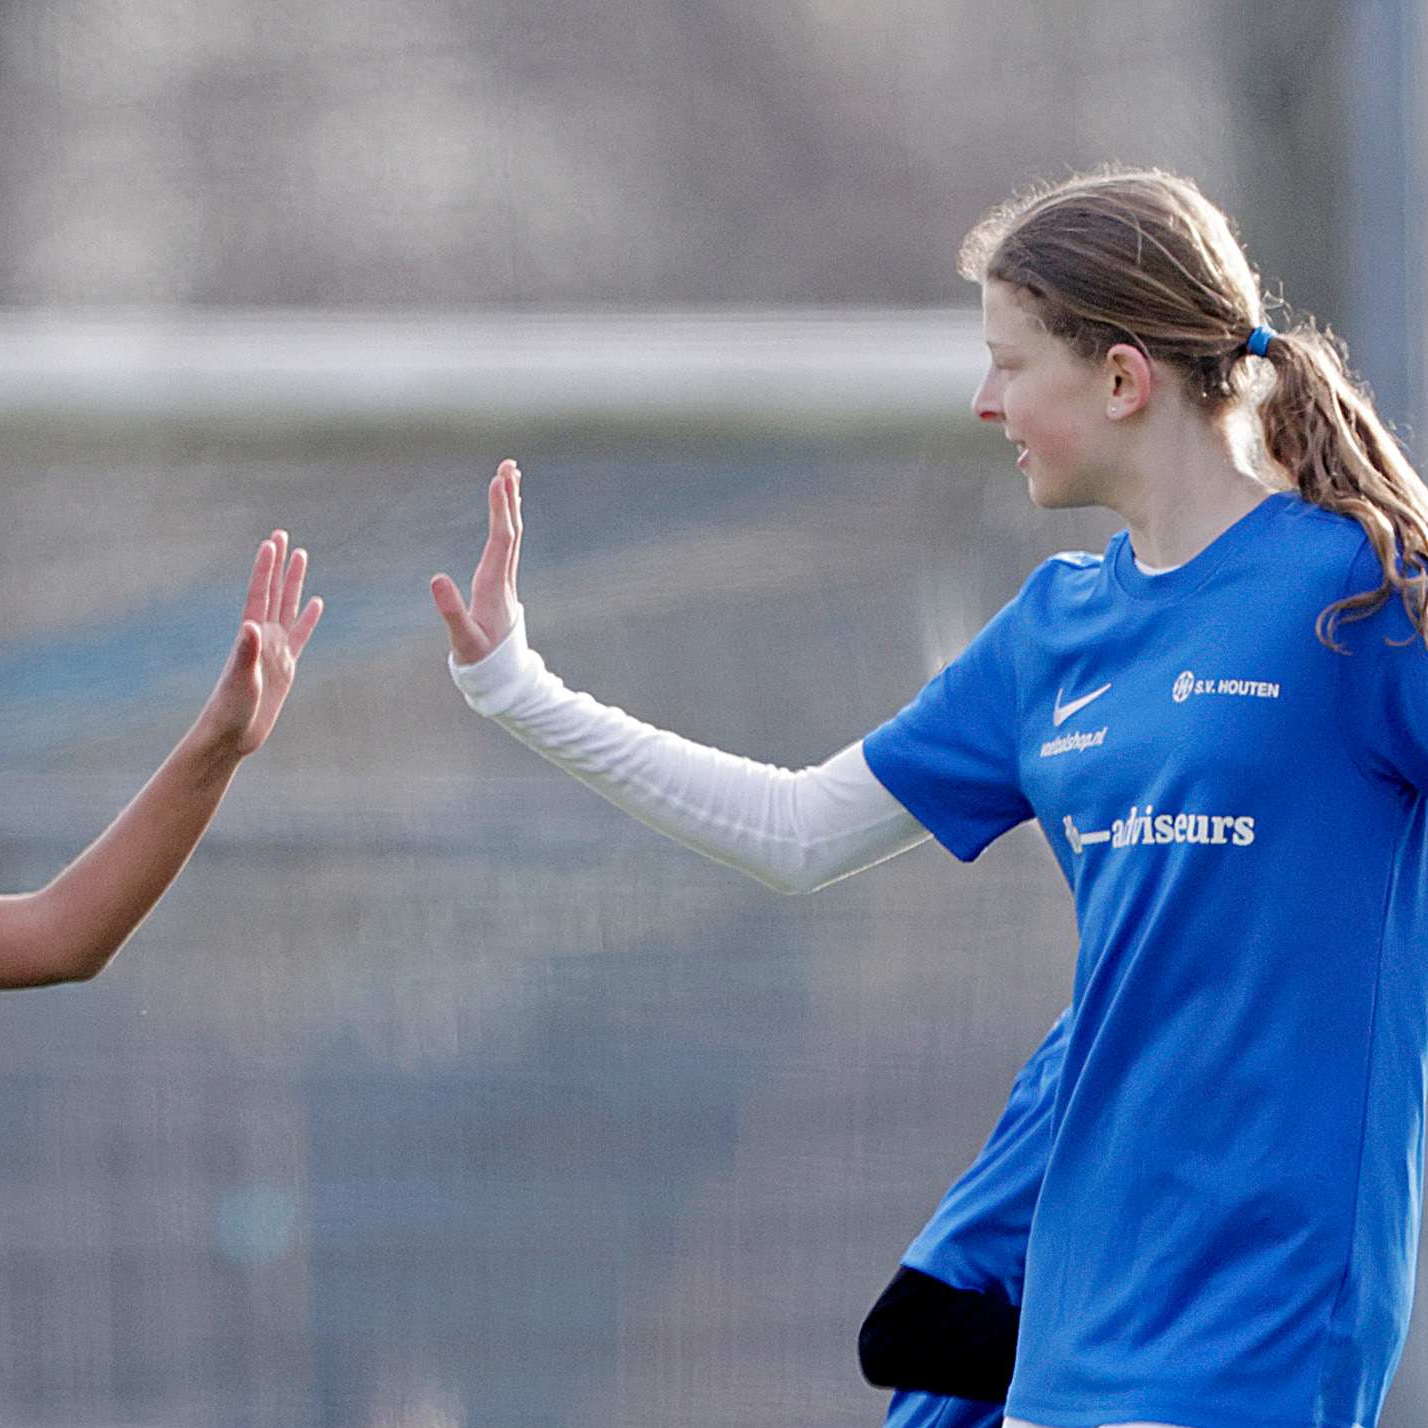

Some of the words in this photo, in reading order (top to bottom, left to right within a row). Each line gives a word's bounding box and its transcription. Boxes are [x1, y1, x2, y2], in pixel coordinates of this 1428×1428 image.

[1194, 679, 1216, 694] S.V.
[1218, 680, 1279, 698] HOUTEN
[1062, 804, 1255, 855] —adviseurs
